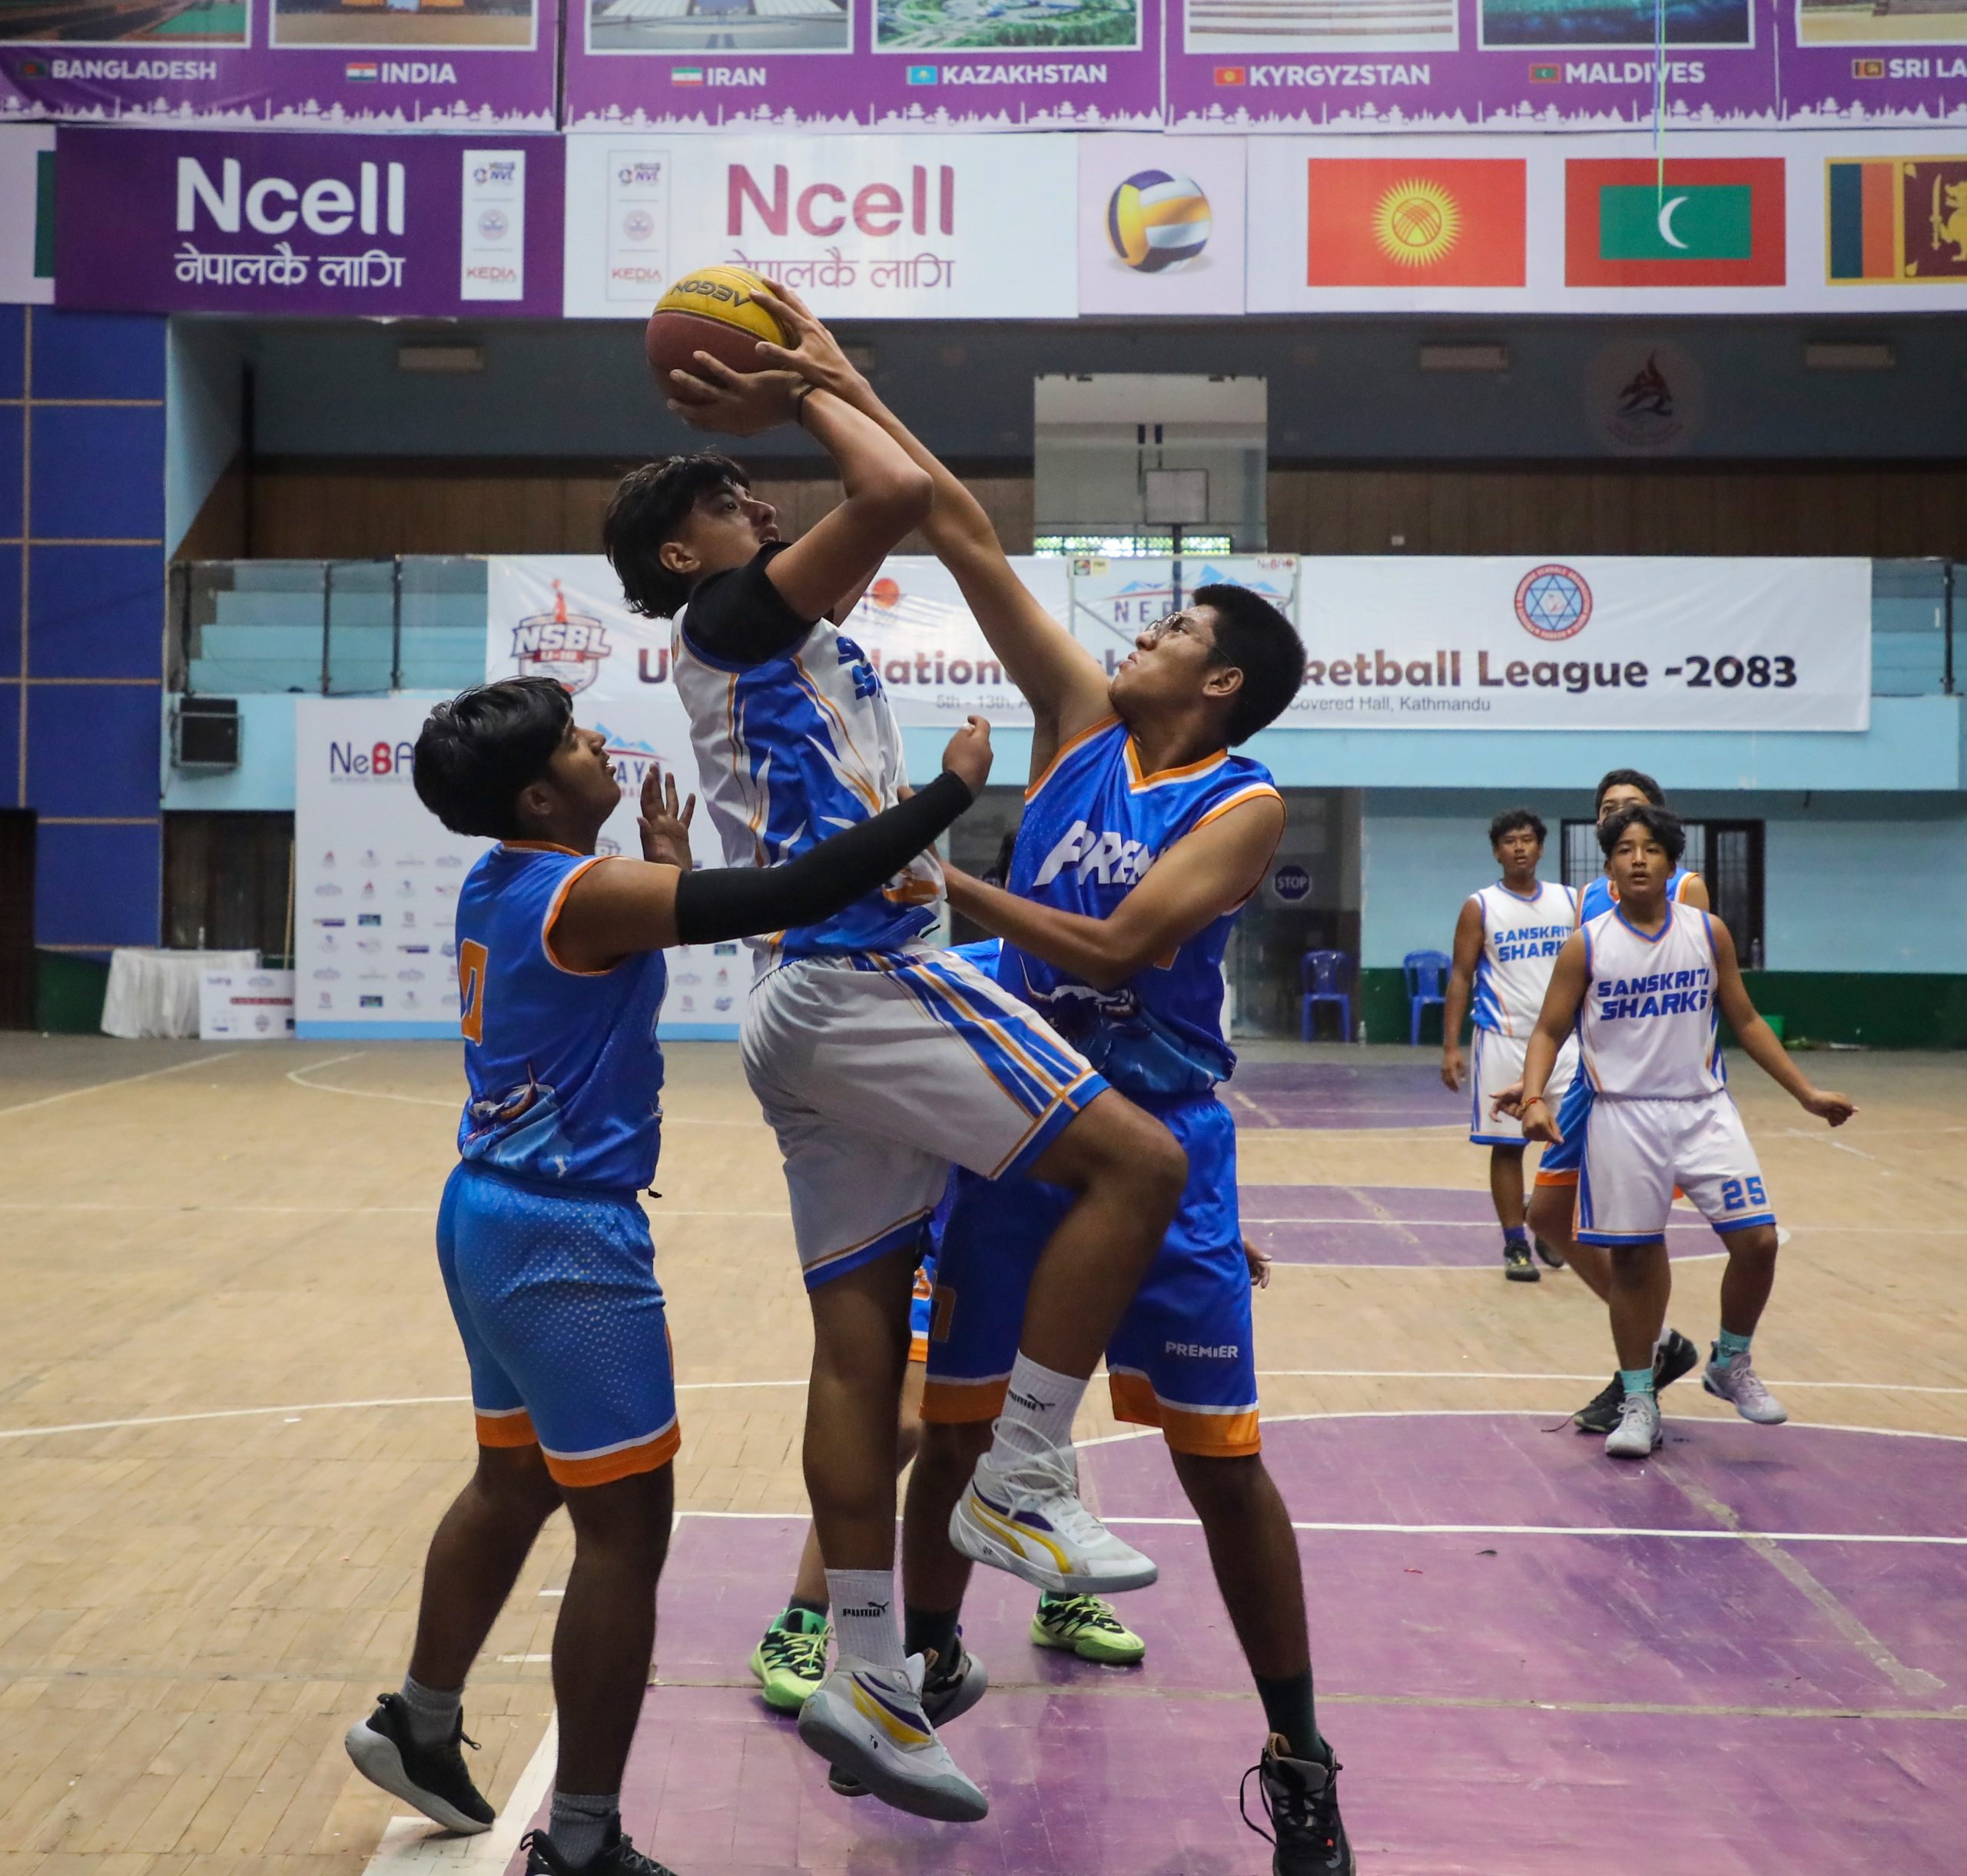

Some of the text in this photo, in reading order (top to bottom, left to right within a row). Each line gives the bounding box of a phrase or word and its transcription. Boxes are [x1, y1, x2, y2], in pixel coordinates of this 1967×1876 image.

[52, 61, 217, 81] BANGLADESH
[382, 63, 457, 85] INDIA
[707, 68, 766, 87] IRAN
[943, 65, 1107, 85] KAZAKHSTAN
[1250, 63, 1431, 87] KYRGYZSTAN
[1565, 62, 1705, 85] MALDIVES
[1889, 58, 1967, 78] SRI LA
[177, 157, 406, 236] Ncell
[728, 163, 954, 237] Ncell
[174, 241, 310, 287] नेपालकै
[511, 623, 612, 658] NSBL
[871, 649, 1017, 685] ation
[1302, 649, 1461, 686] ketball
[1478, 651, 1648, 693] League
[1665, 656, 1797, 688] -2083
[1360, 697, 1394, 712] Hall,
[1400, 696, 1491, 712] Kathmandu
[1276, 877, 1307, 888] STOP
[1494, 925, 1574, 945] SANSKRIT
[1722, 1176, 1766, 1210] 25
[1165, 1341, 1239, 1359] PREMIER
